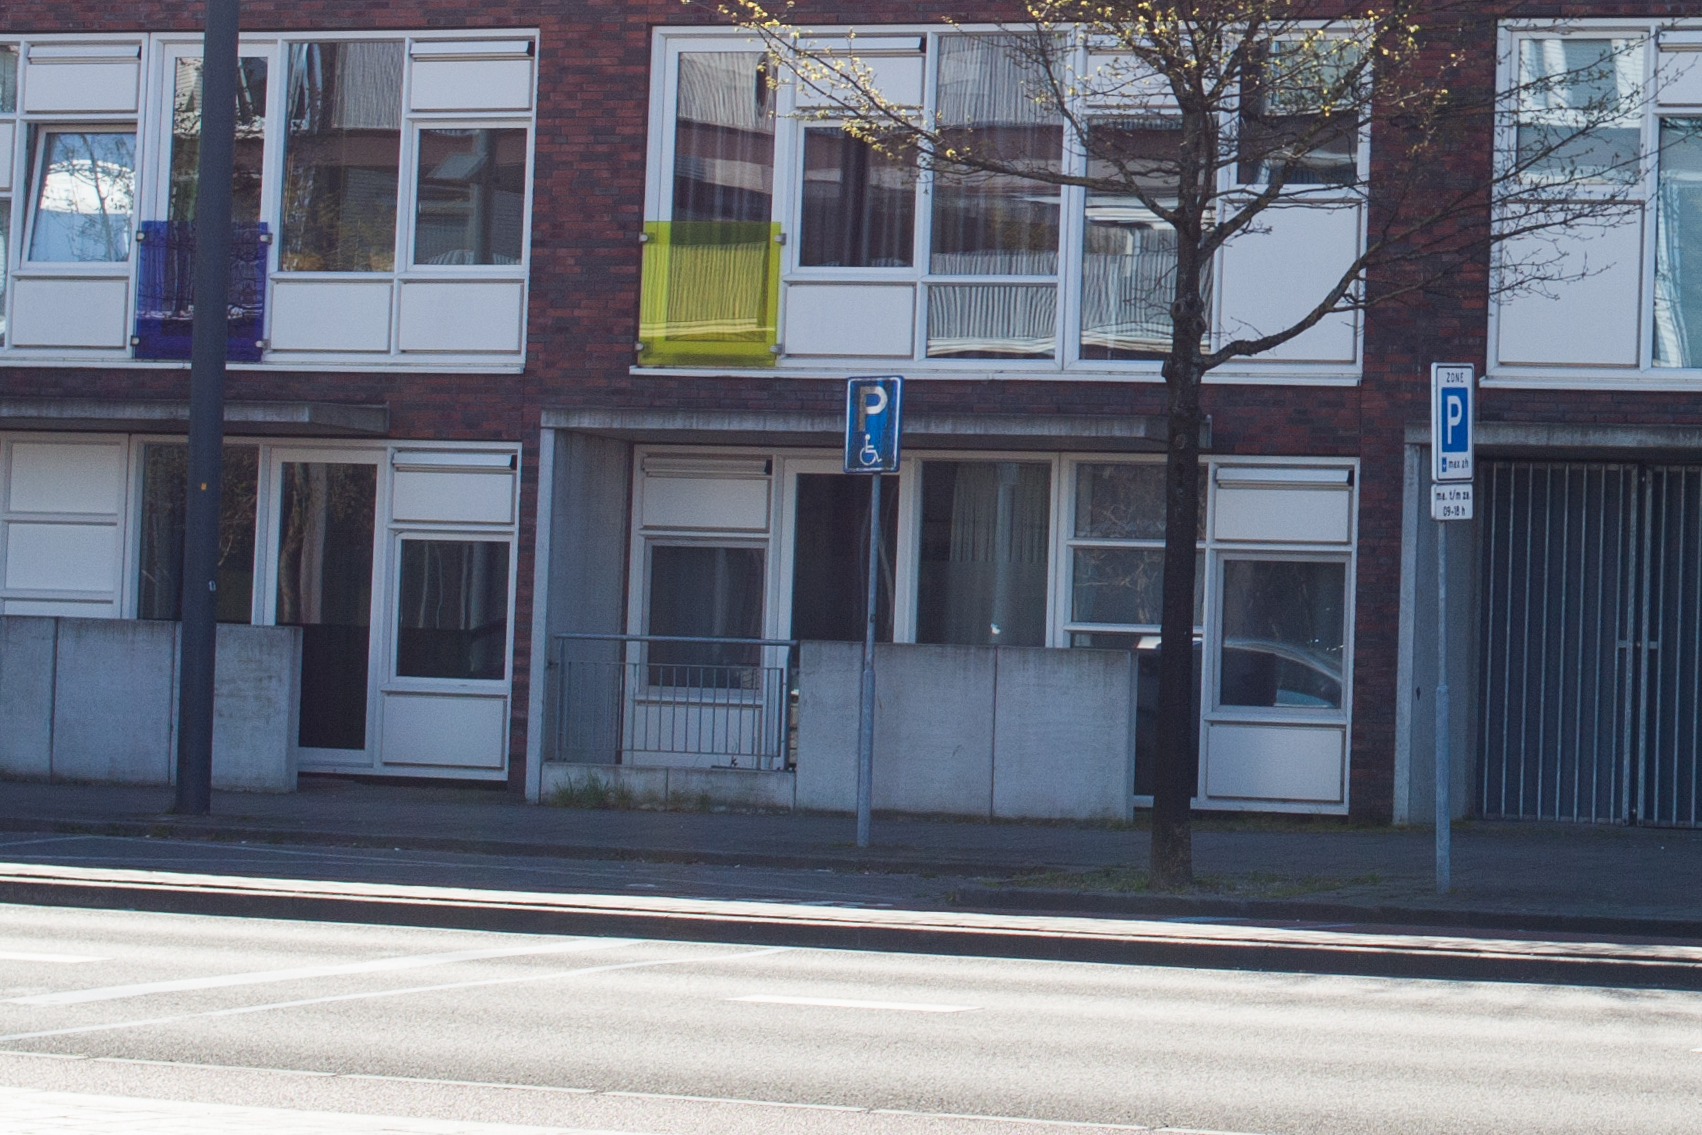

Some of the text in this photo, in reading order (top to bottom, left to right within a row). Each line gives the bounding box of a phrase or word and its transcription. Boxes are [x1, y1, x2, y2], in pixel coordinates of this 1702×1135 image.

[1446, 372, 1464, 383] ZONE
[858, 386, 888, 432] P
[1447, 395, 1462, 444] P
[1448, 460, 1460, 469] max
[1449, 490, 1461, 501] t/m
